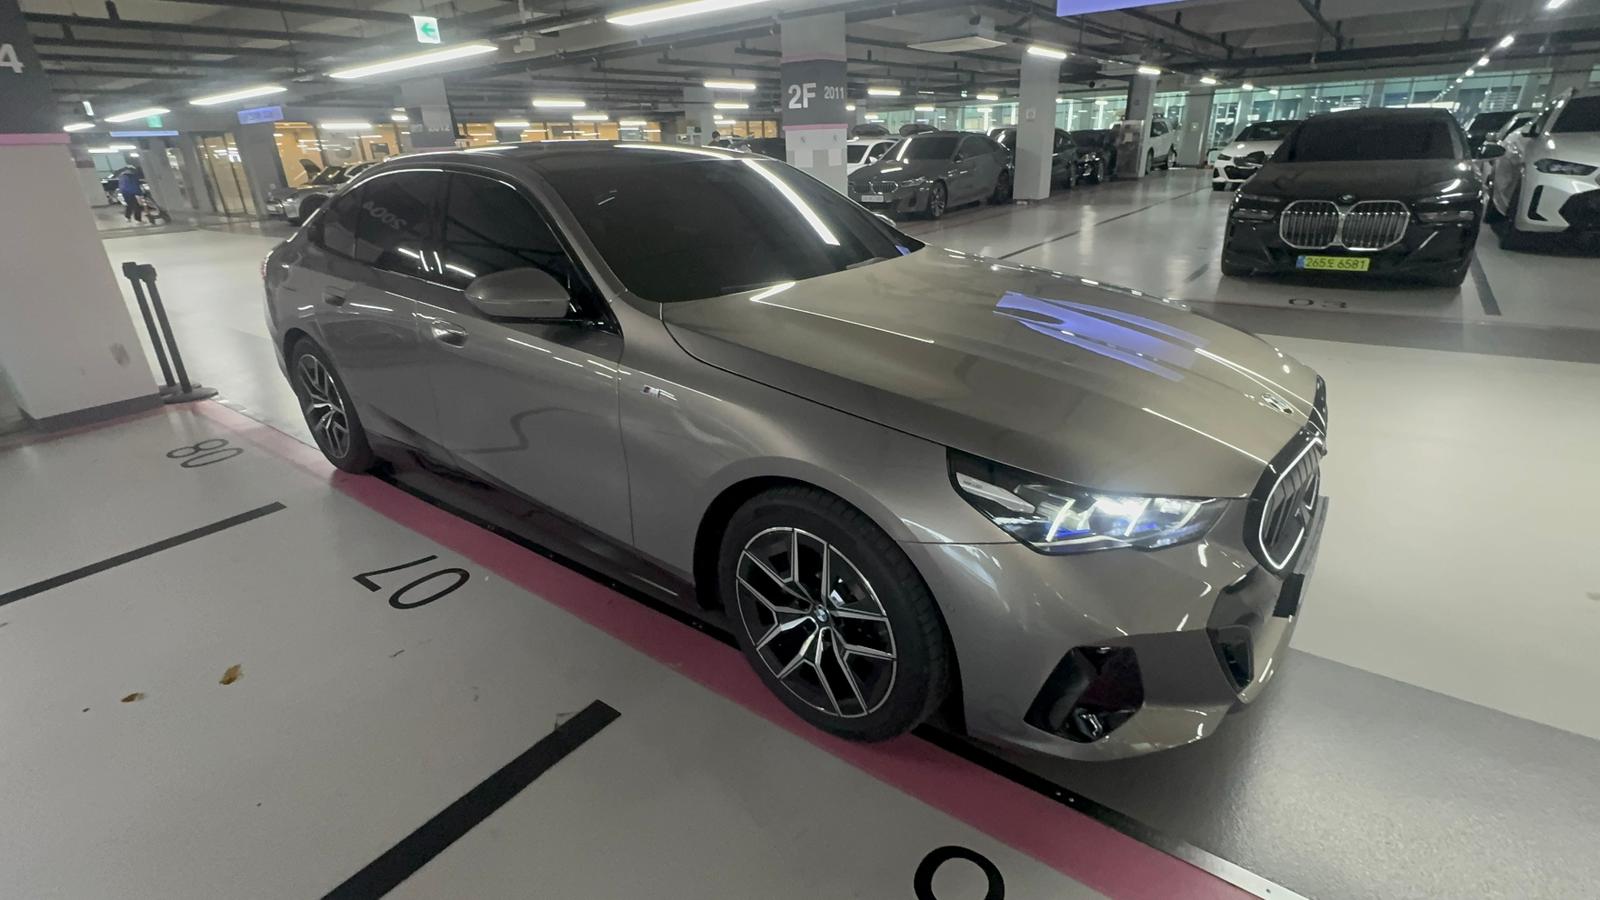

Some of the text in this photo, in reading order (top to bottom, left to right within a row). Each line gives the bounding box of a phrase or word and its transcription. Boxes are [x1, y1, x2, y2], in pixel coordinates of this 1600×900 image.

[788, 82, 845, 109] 2F 2011
[1336, 259, 1366, 270] 6581
[352, 554, 470, 610] 07
